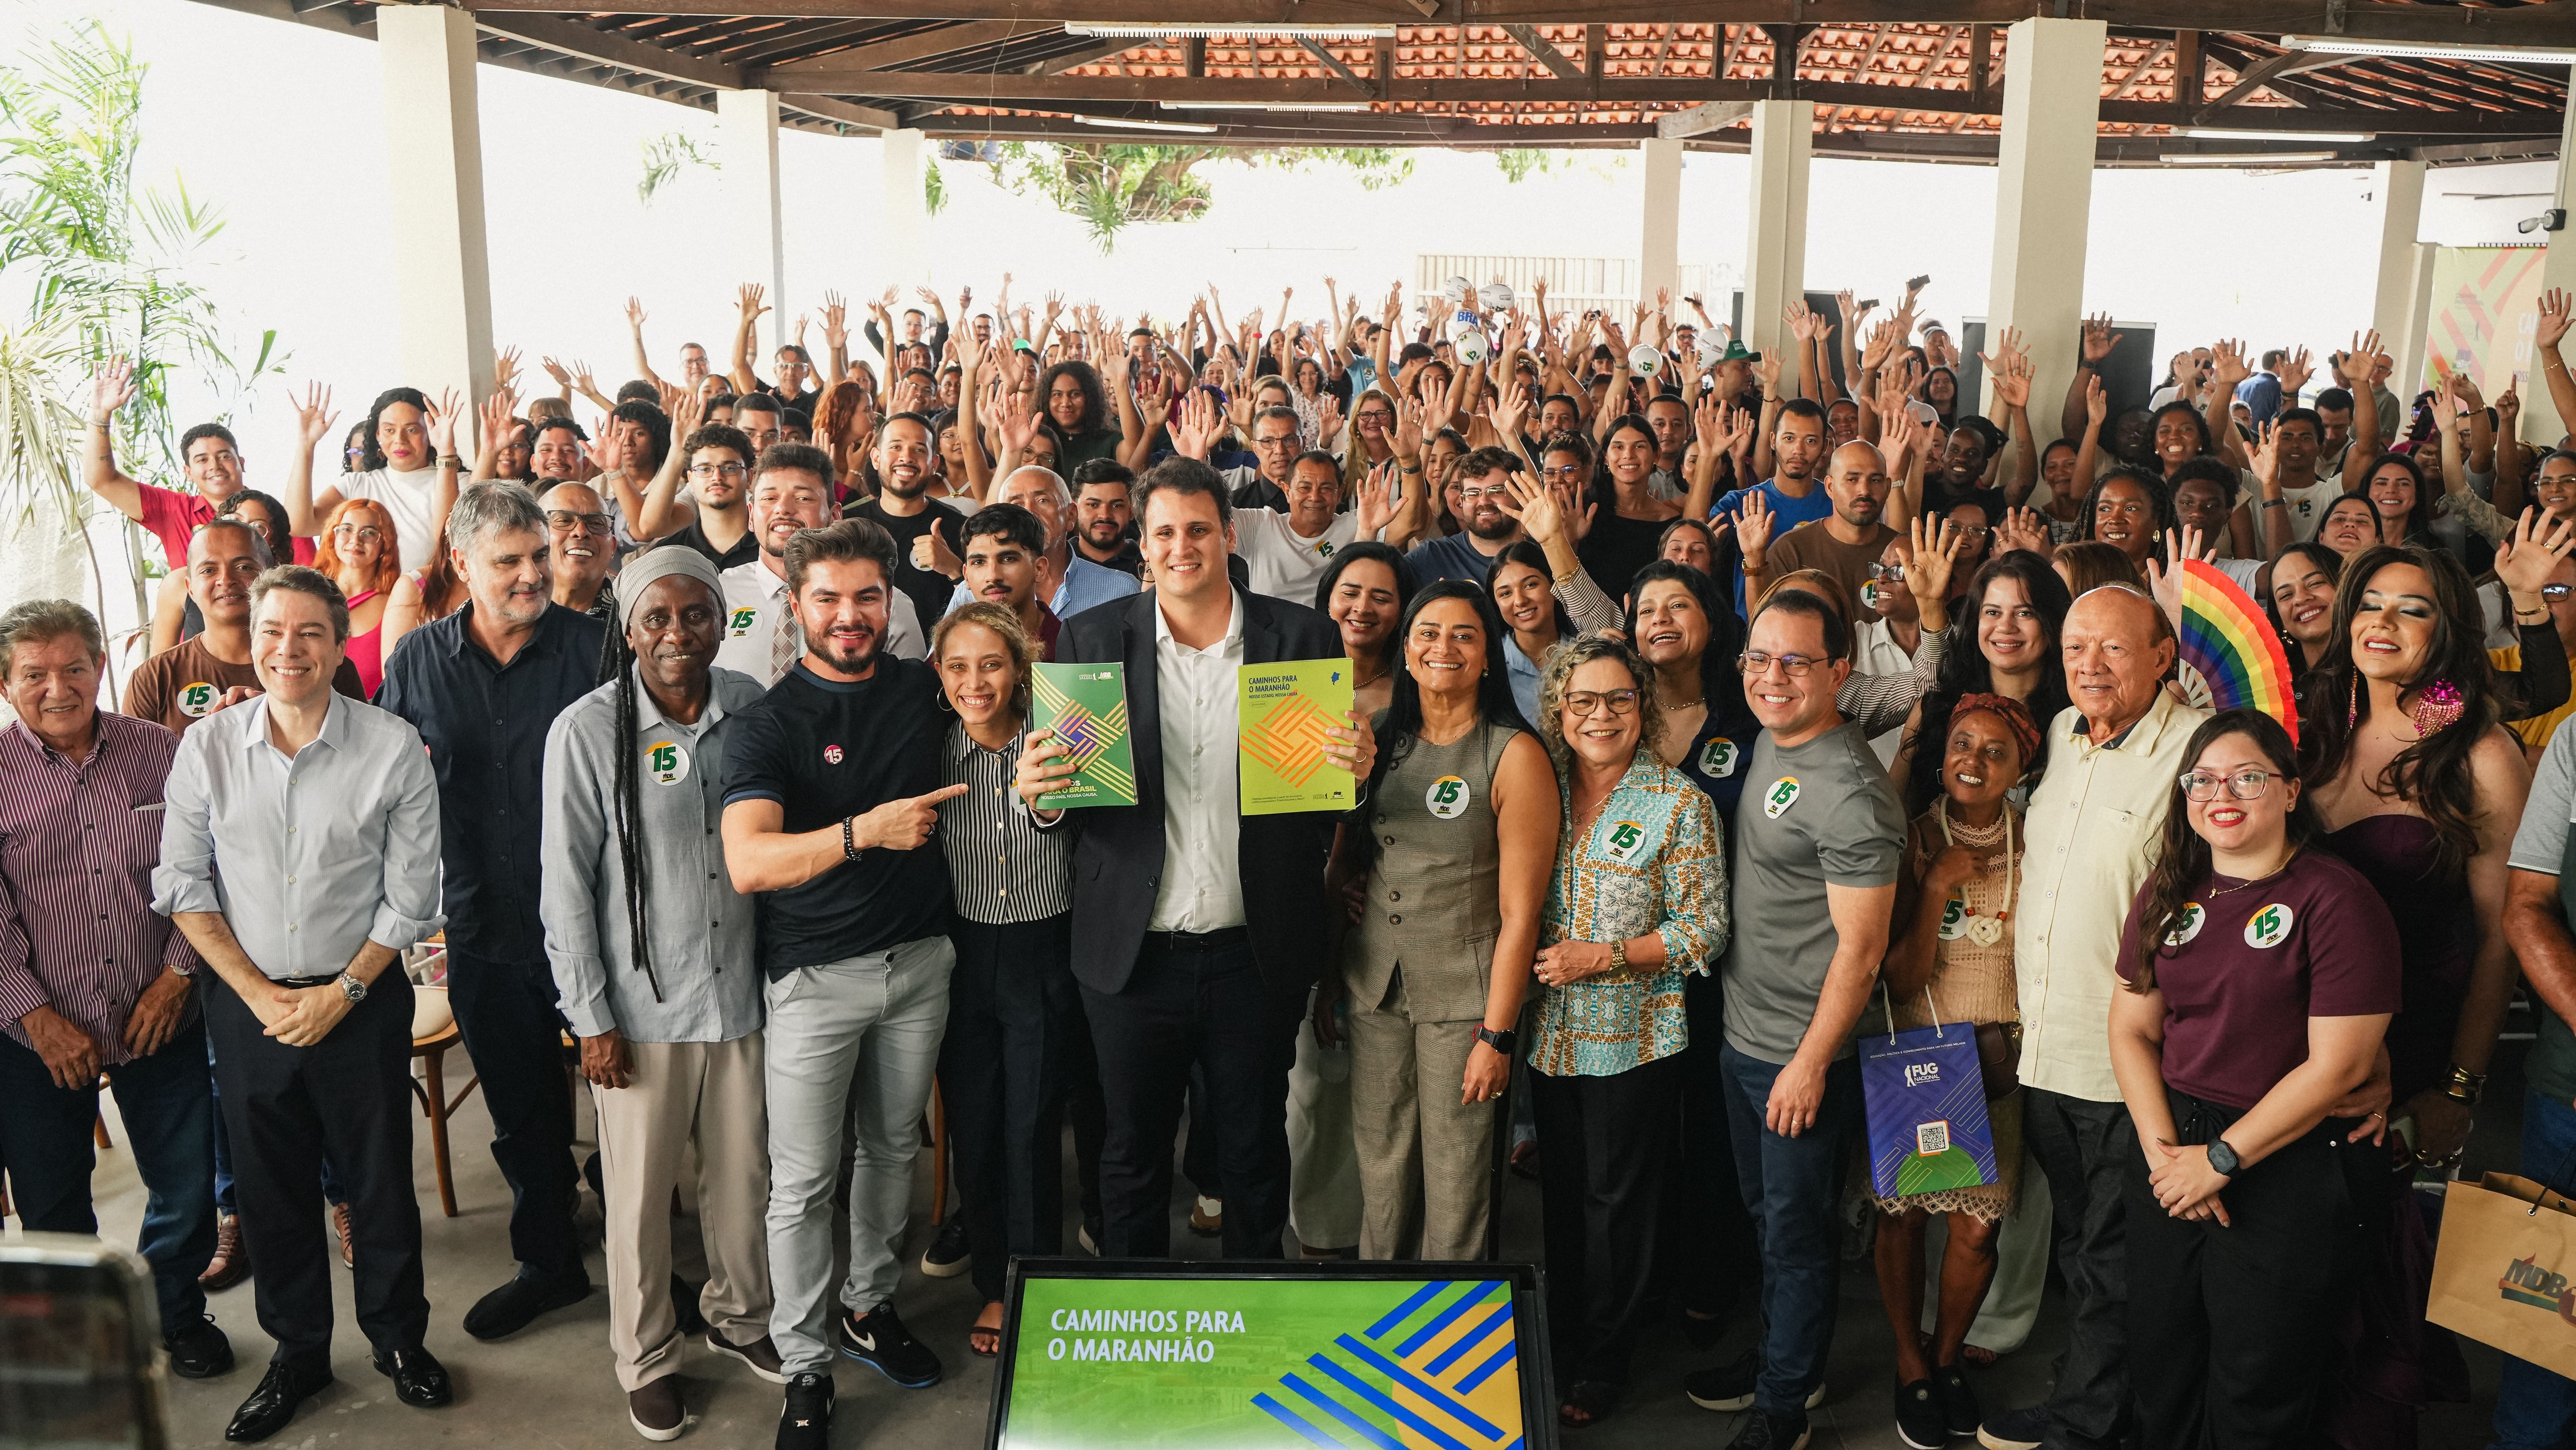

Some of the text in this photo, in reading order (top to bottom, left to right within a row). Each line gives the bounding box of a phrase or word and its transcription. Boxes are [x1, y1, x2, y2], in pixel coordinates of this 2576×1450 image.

[2298, 500, 2311, 513] 15
[1319, 541, 1334, 557] 15
[730, 611, 756, 629] 15
[1249, 676, 1280, 684] CAMINHOS
[1255, 683, 1290, 692] MARANHÃO
[186, 686, 210, 705] 15
[652, 746, 677, 772] 15
[826, 749, 842, 762] 15
[1705, 742, 1731, 765] 15
[1433, 781, 1462, 803] 15
[1771, 781, 1797, 804] 15
[1609, 824, 1642, 848] 15
[1612, 847, 1624, 856] MDB
[1942, 900, 1963, 924] 5
[2178, 908, 2200, 931] 5
[2254, 907, 2280, 940] 15
[2267, 933, 2278, 942] MDB
[1912, 1062, 1938, 1076] FUG
[2504, 1257, 2567, 1299] MDB
[1051, 1309, 1246, 1333] CAMINHOS PARA
[1048, 1336, 1214, 1363] O MARANHÃO
